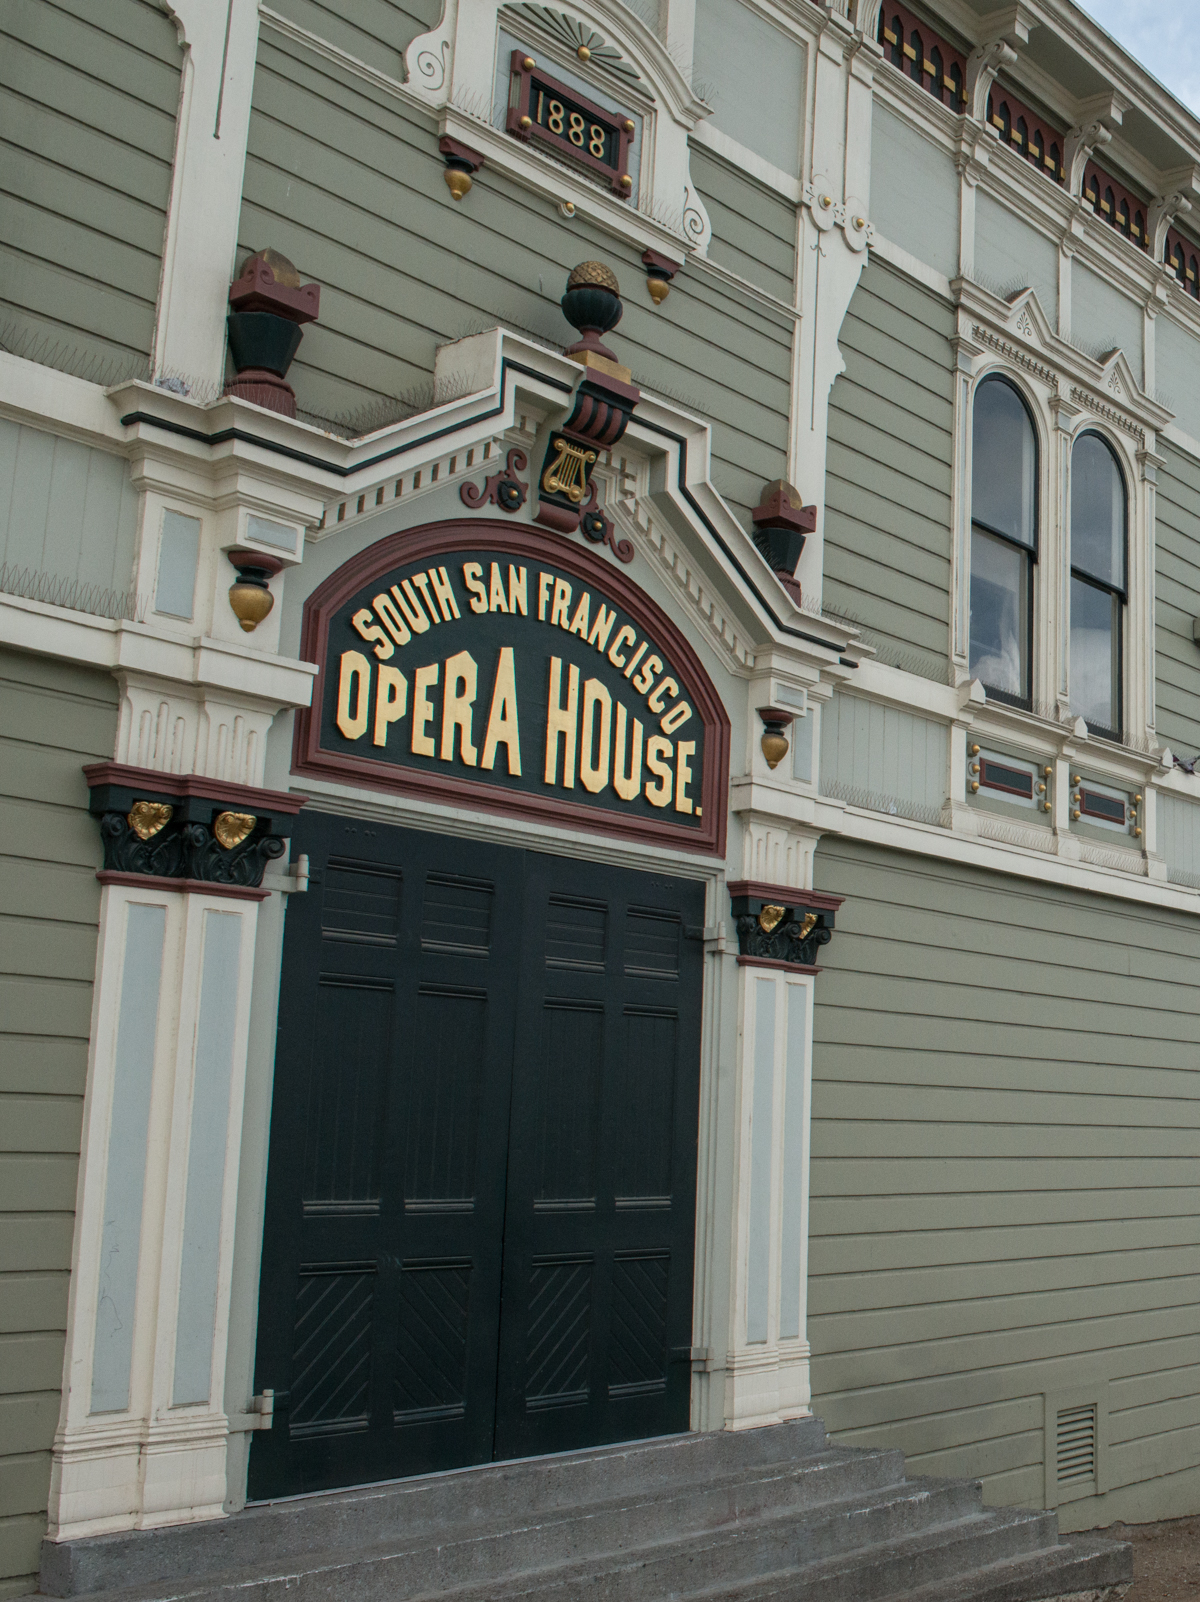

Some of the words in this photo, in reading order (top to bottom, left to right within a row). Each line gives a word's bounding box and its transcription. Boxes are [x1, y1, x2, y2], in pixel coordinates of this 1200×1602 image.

[537, 90, 605, 158] 1888
[336, 646, 522, 778] OPERA
[352, 566, 461, 660] SOUTH
[462, 561, 528, 616] SAN
[537, 571, 693, 735] FRANCISCO
